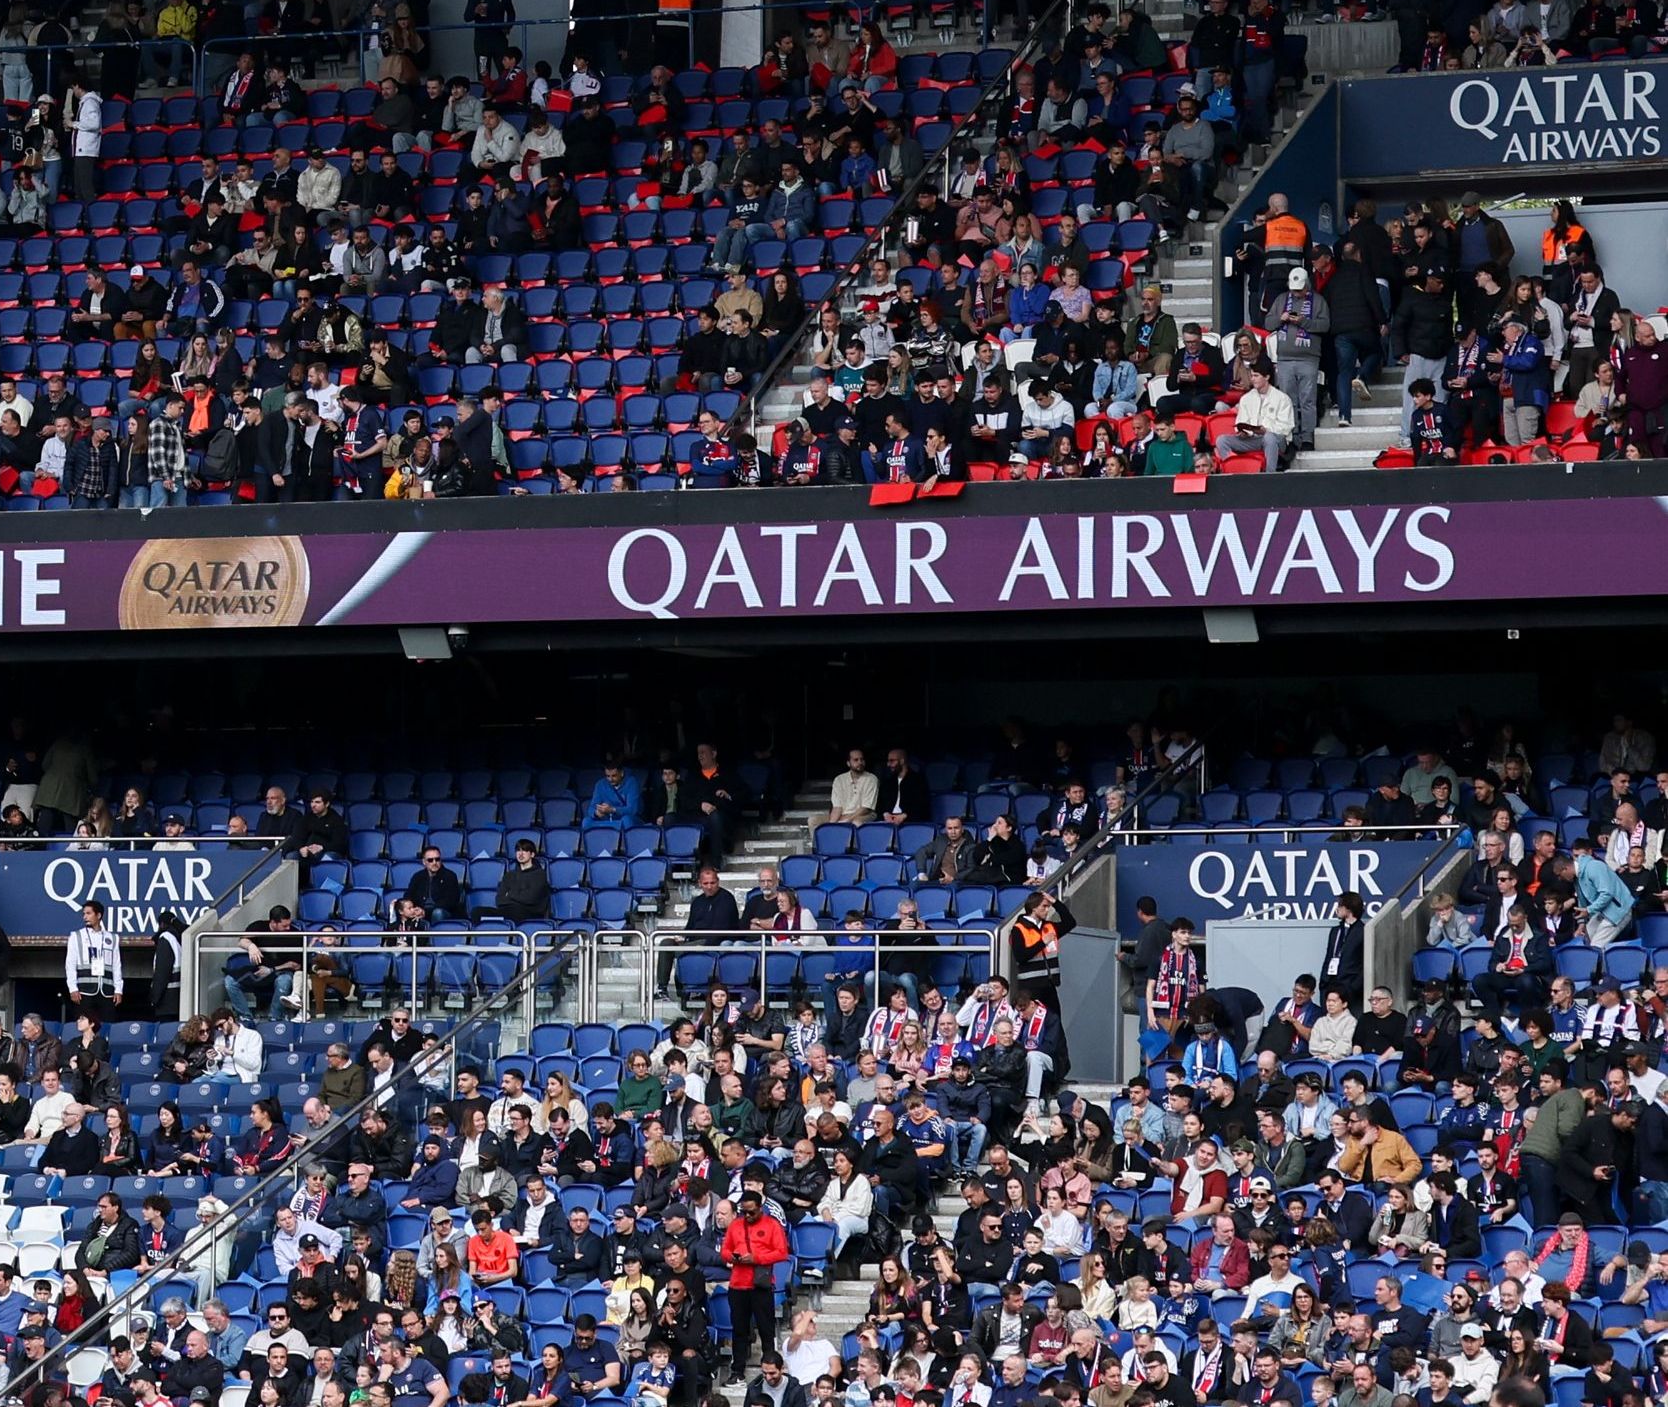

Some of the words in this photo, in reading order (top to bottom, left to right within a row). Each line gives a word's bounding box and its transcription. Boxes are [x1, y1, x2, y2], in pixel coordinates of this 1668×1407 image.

[1450, 71, 1660, 140] QATAR
[1502, 126, 1661, 162] AIRWAYS
[144, 561, 280, 596] QATAR
[607, 521, 954, 619] QATAR
[998, 505, 1454, 601] AIRWAYS
[168, 595, 277, 615] AIRWAYS
[43, 857, 214, 912] QATAR
[1189, 849, 1383, 910] QATAR
